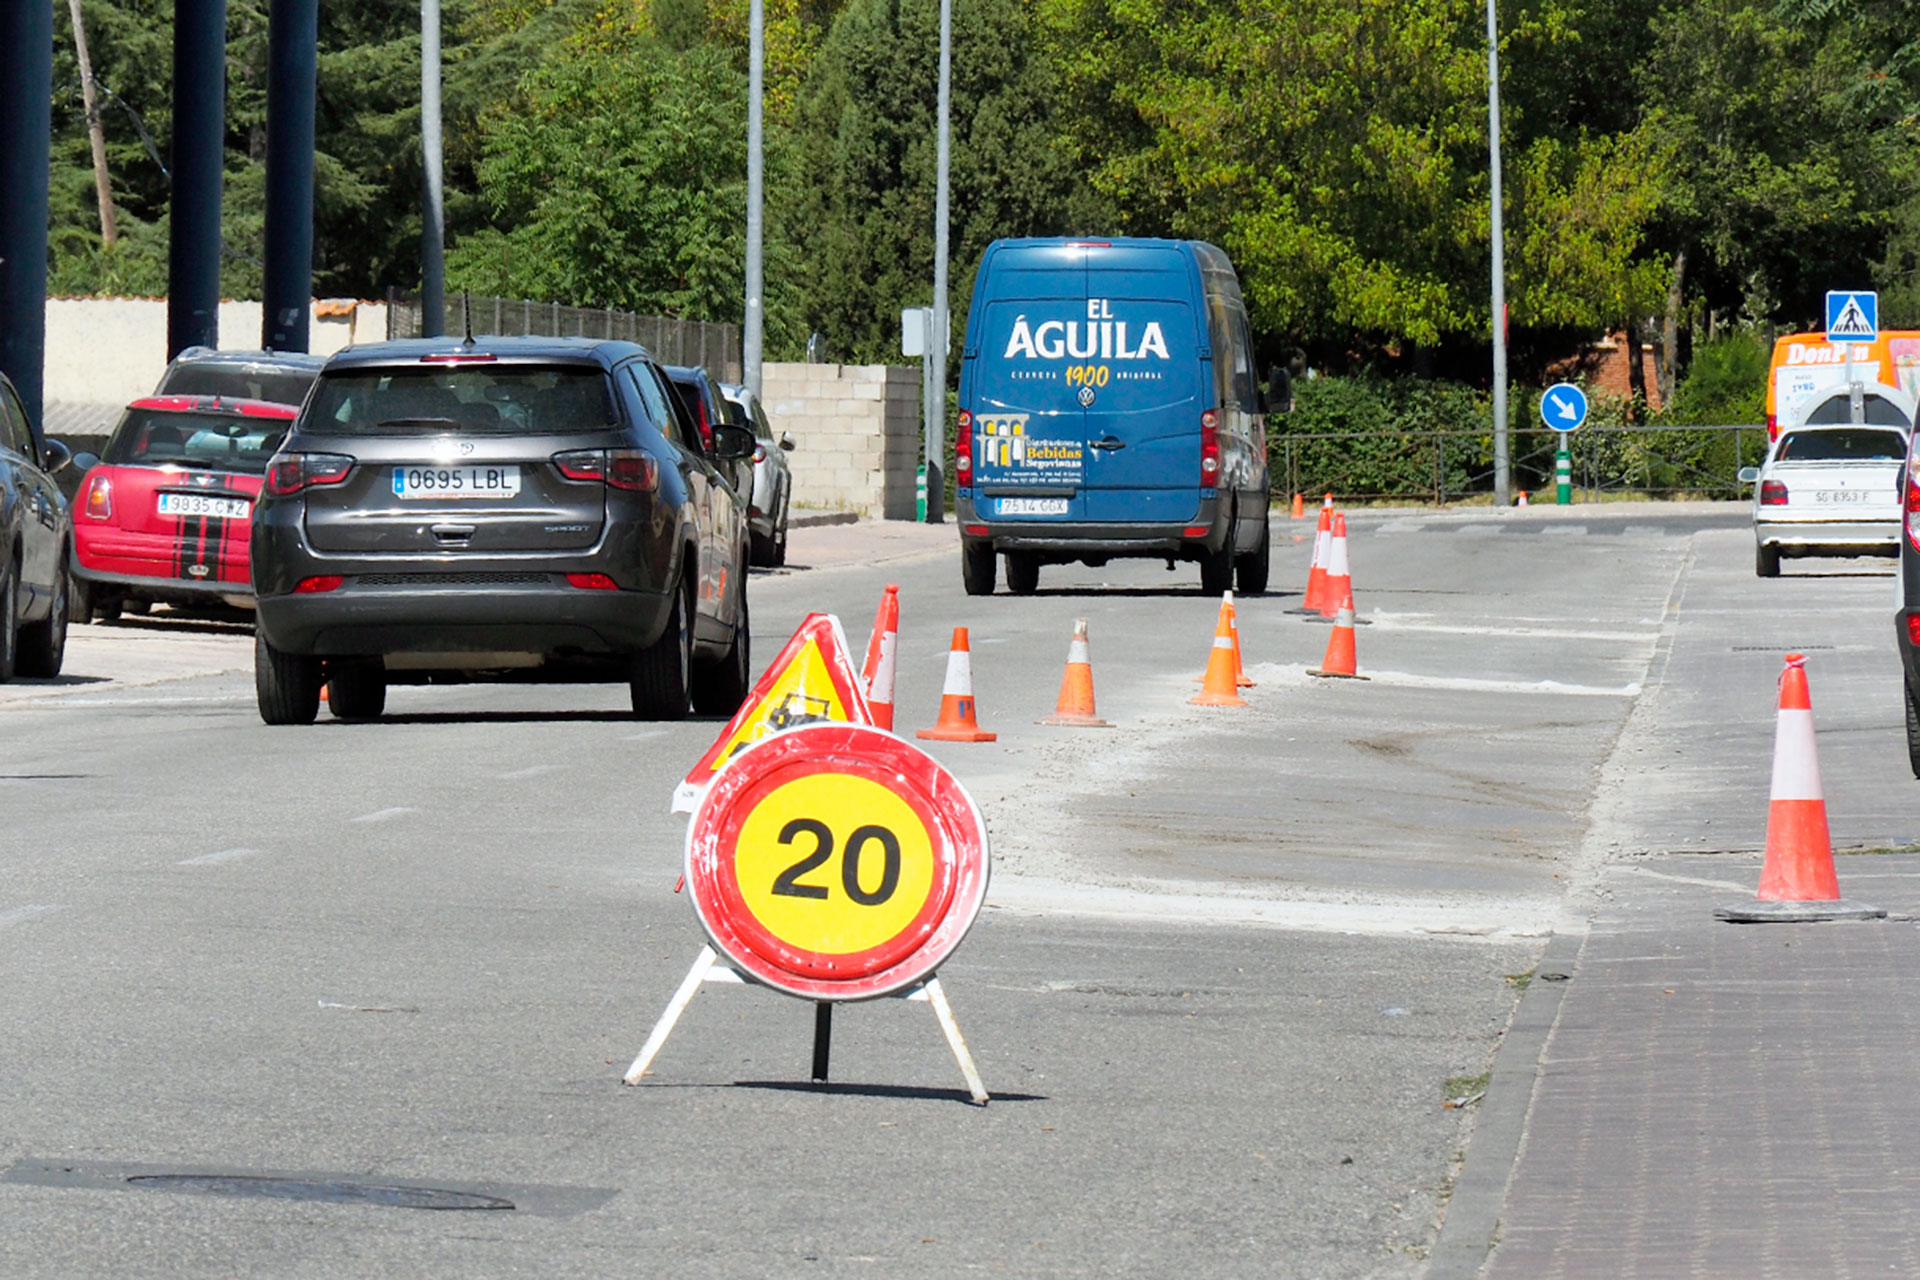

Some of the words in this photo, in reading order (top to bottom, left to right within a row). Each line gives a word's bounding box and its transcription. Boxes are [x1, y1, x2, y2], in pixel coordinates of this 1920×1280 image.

[1087, 299, 1114, 319] EL
[1003, 314, 1170, 359] ÁGUILA
[1786, 343, 1869, 364] DonPn
[1065, 365, 1110, 387] 1900
[1027, 446, 1082, 459] Bebidas
[1026, 458, 1082, 470] Segovianas
[408, 468, 463, 490] 0695
[472, 468, 513, 490] LBL
[171, 496, 210, 512] 9835
[1005, 499, 1035, 512] 7514
[770, 817, 901, 907] 20
